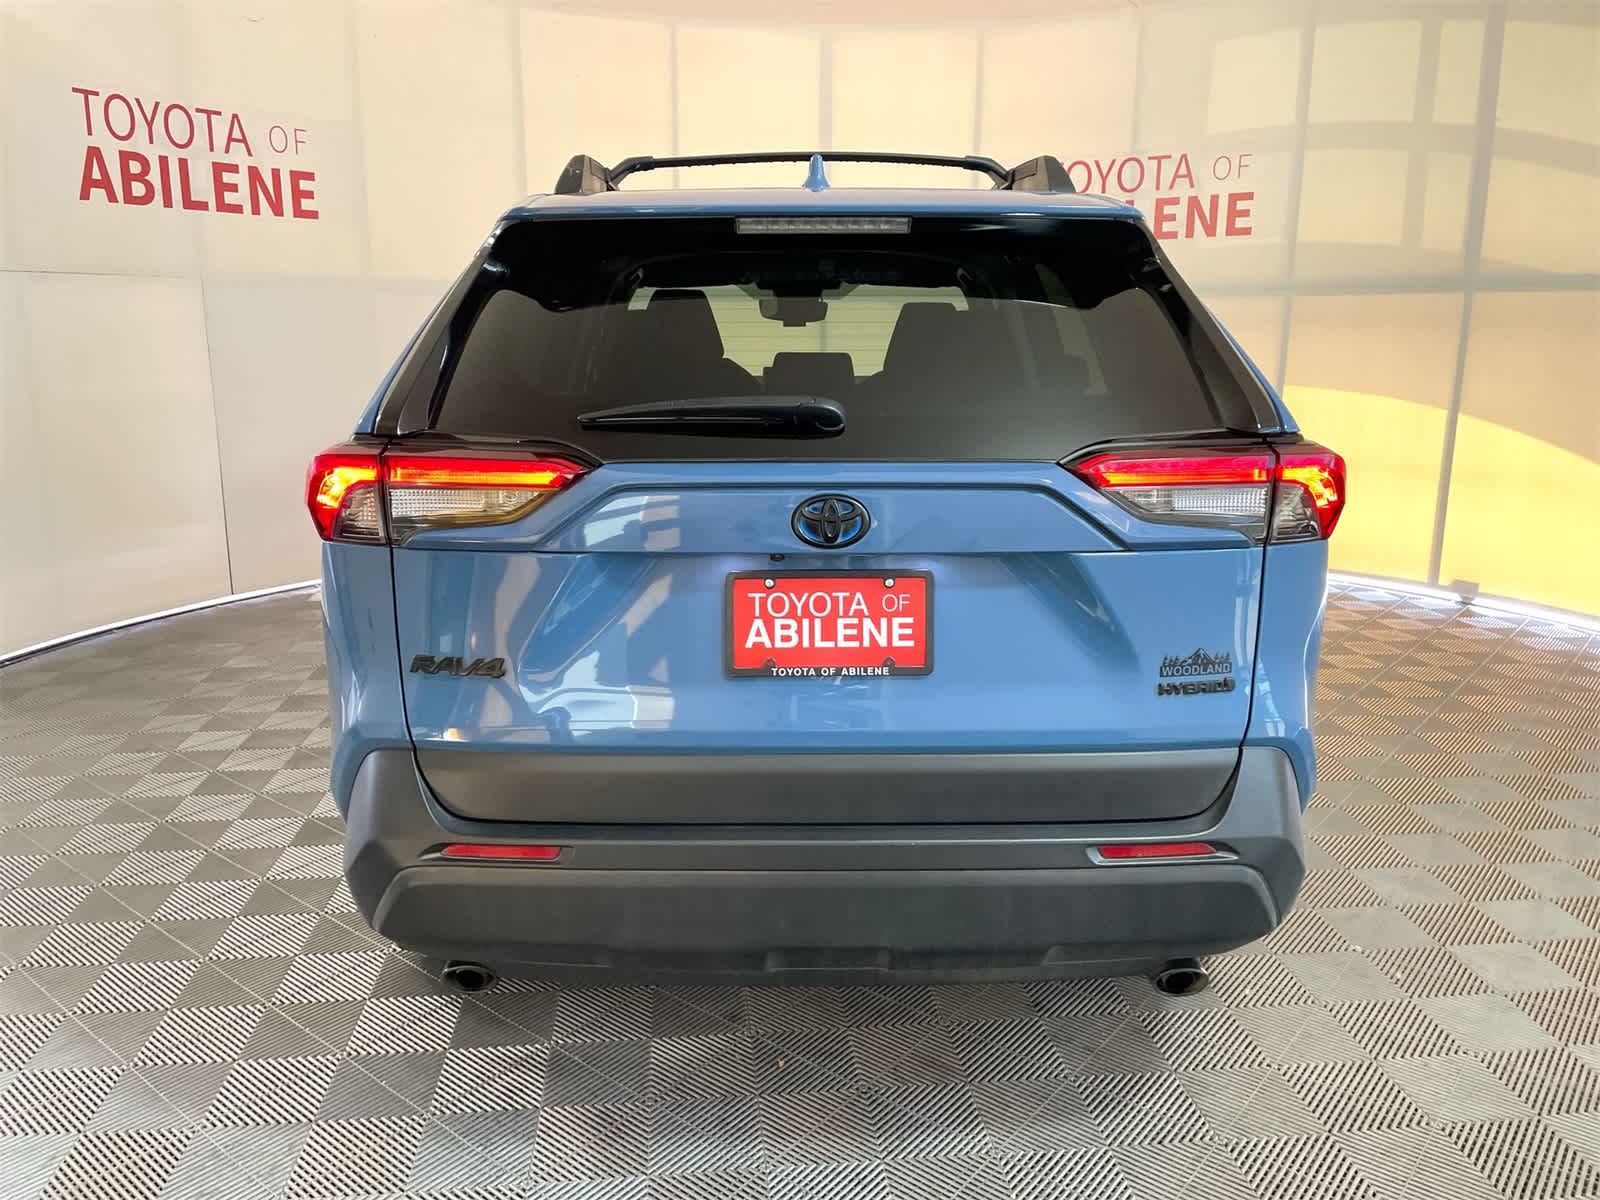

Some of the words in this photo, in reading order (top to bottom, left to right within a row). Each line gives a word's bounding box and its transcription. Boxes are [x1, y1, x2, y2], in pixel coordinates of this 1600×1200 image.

[71, 86, 253, 157] TOYOTA
[268, 125, 307, 154] OF
[79, 145, 319, 220] ABILENE
[1061, 153, 1195, 194] OYOTA
[1212, 153, 1253, 181] OF
[747, 592, 869, 617] TOYOTA
[881, 593, 911, 612] OF
[744, 617, 915, 648] ABILENE
[409, 655, 506, 679] RAV4
[771, 667, 816, 677] TOYOTA
[821, 667, 836, 676] OF
[841, 666, 890, 676] ABILENE
[1161, 663, 1231, 676] WOODLAND
[1157, 678, 1236, 697] HYBRID
